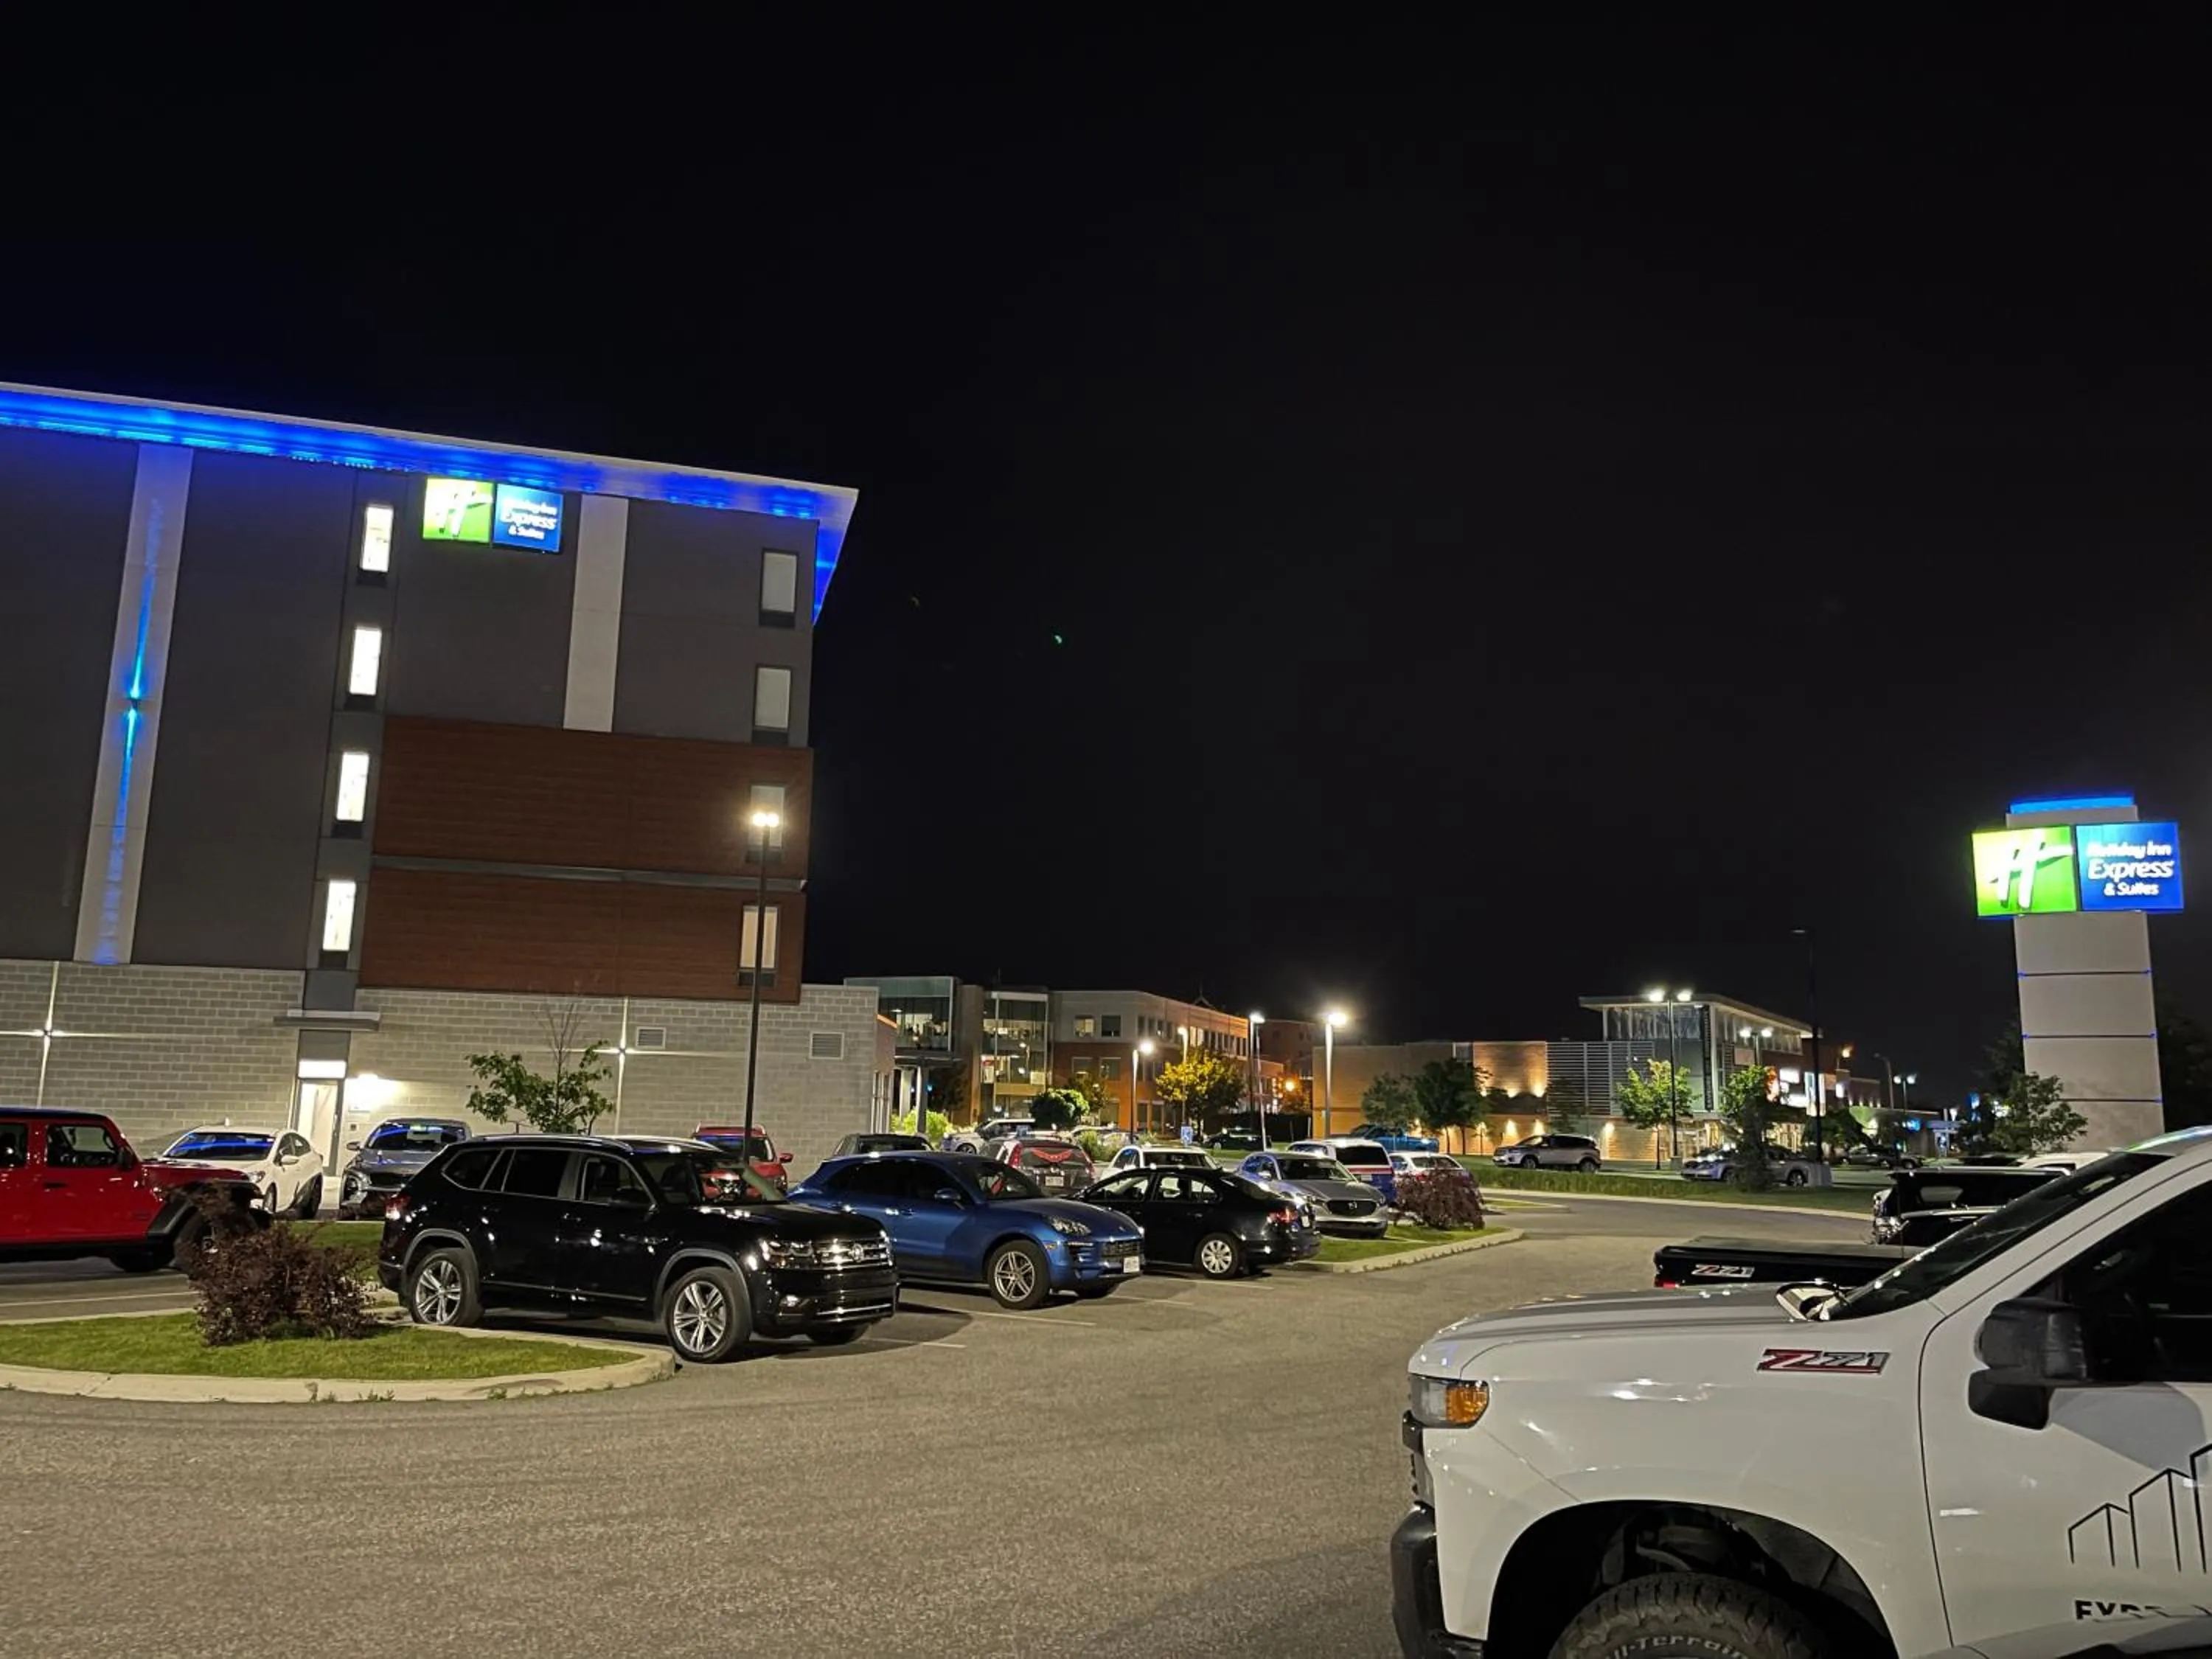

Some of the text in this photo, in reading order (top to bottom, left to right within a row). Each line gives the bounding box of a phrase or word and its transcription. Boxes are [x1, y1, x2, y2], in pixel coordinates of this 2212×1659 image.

[2147, 841, 2171, 856] Inn
[2088, 859, 2174, 883] Express
[2104, 882, 2159, 896] & Suites
[1691, 1265, 1755, 1278] Z71
[1757, 1349, 1889, 1374] Z71
